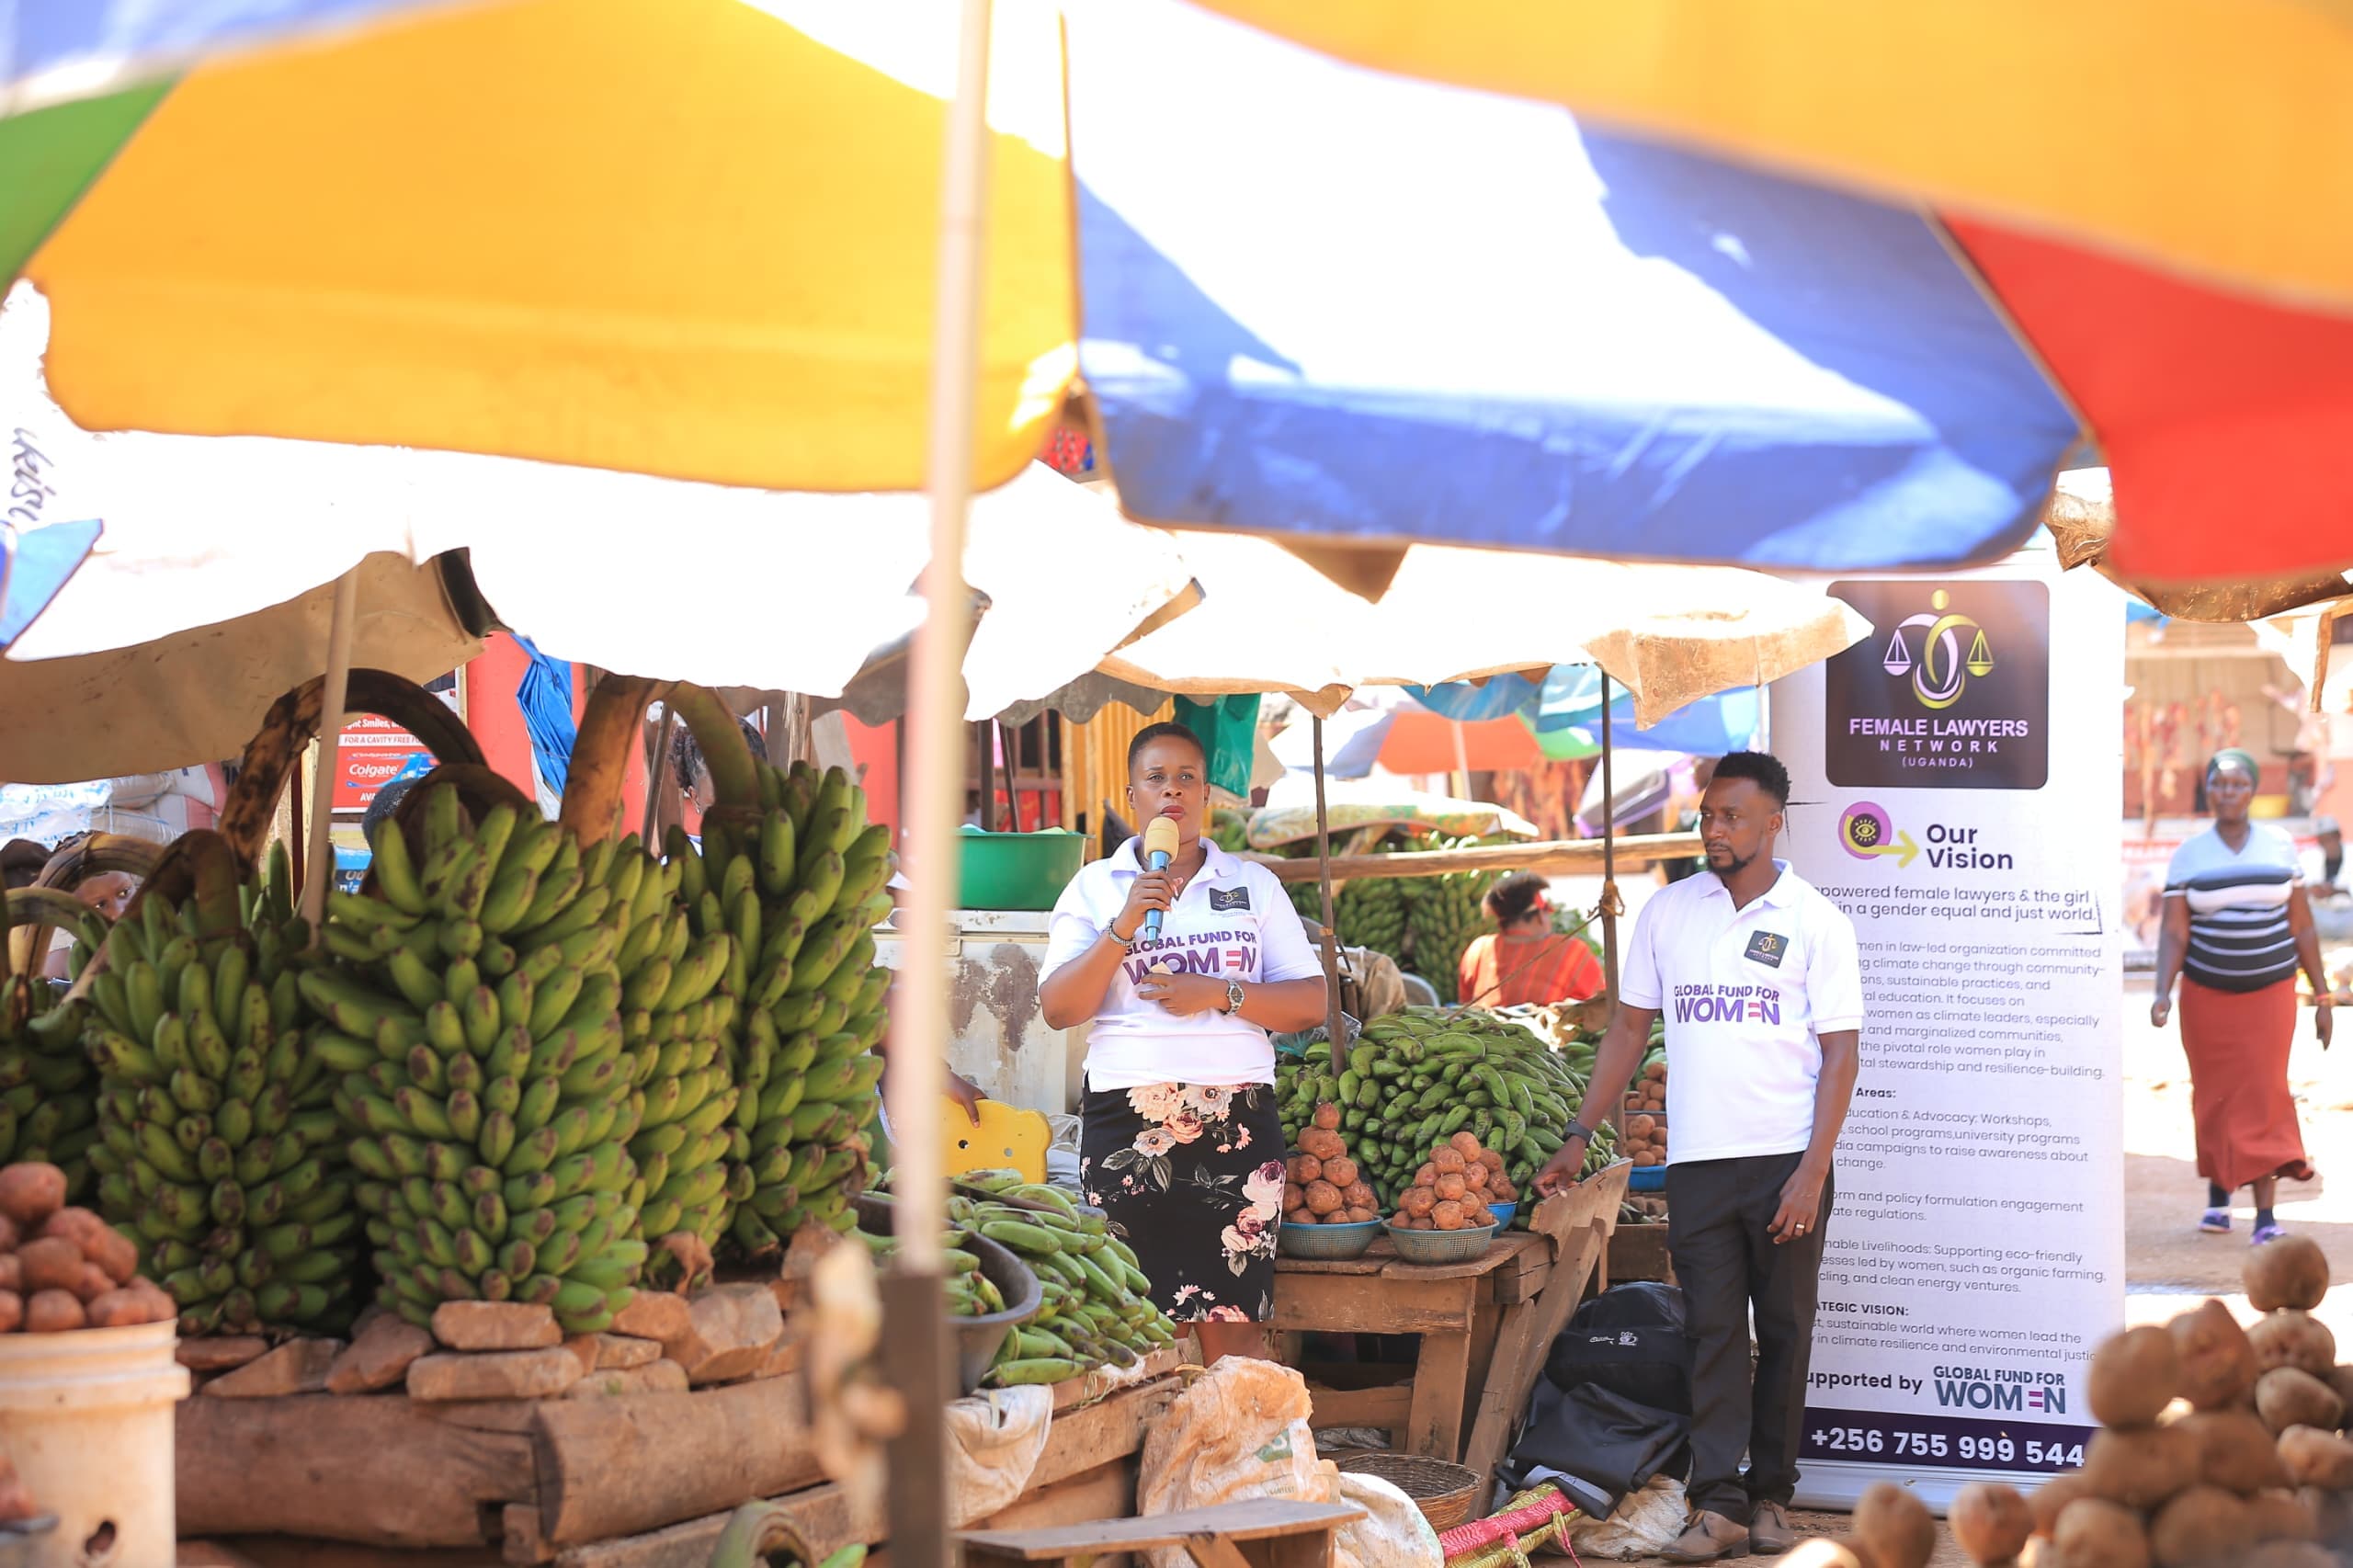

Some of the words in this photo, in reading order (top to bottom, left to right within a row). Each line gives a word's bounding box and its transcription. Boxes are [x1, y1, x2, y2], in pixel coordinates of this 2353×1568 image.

[1849, 718, 1927, 735] FEMALE
[1933, 719, 2029, 736] LAWYERS
[1880, 739, 1998, 753] NETWORK
[349, 763, 398, 778] Colgate
[1902, 756, 1973, 768] (UGANDA)
[1927, 824, 1978, 844] Our
[1927, 846, 2013, 869] Vision
[1814, 886, 1890, 898] powered
[1894, 886, 1949, 899] female
[1954, 887, 2016, 904] lawyers
[2018, 890, 2029, 902] &
[2034, 890, 2060, 903] the
[2064, 890, 2089, 907] girl
[1857, 905, 1867, 915] a
[1870, 903, 1927, 919] gender
[1930, 904, 1976, 921] equal
[1980, 905, 2012, 918] and
[2015, 905, 2044, 923] just
[1188, 931, 1233, 946] FUND
[1234, 931, 1257, 944] FOR
[1886, 941, 1896, 951] in
[1899, 942, 1946, 953] law-led
[1949, 944, 2027, 957] organization
[2030, 947, 2101, 958] committed
[1873, 958, 1919, 970] climate
[1922, 960, 1971, 974] change
[1973, 960, 2023, 975] through
[2026, 963, 2106, 978] community-
[1887, 975, 1959, 987] sustainable
[1961, 978, 2023, 990] practices,
[2025, 980, 2051, 990] and
[1674, 983, 1714, 997] GLOBAL
[1718, 984, 1753, 997] FUND
[1756, 985, 1780, 1002] FOR
[1878, 993, 1943, 1003] education.
[1947, 994, 1954, 1003] It
[1957, 994, 2006, 1006] focuses
[2008, 997, 2025, 1006] on
[1867, 1009, 1913, 1019] women
[1915, 1011, 1931, 1020] as
[1933, 1009, 1981, 1021] climate
[1984, 1012, 2033, 1025] leaders,
[2035, 1015, 2099, 1028] especially
[1868, 1026, 1892, 1035] and
[1895, 1027, 1975, 1040] marginalized
[1978, 1029, 2063, 1043] communities,
[1860, 1041, 1881, 1051] the
[1883, 1041, 1925, 1054] pivotal
[1928, 1044, 1951, 1054] role
[1955, 1046, 2002, 1056] women
[2005, 1047, 2031, 1060] play
[2034, 1047, 2045, 1058] in
[1878, 1058, 1954, 1074] stewardship
[1957, 1062, 1983, 1073] and
[1856, 1087, 1896, 1098] Areas:
[1901, 1110, 1910, 1119] &
[1981, 1113, 2052, 1129] Workshops,
[1847, 1125, 1888, 1135] school
[2018, 1132, 2080, 1146] programs
[1856, 1142, 1927, 1156] campaigns
[1930, 1145, 1942, 1155] to
[1945, 1145, 1976, 1156] raise
[1978, 1148, 2048, 1160] awareness
[2051, 1151, 2088, 1162] about
[1836, 1157, 1887, 1171] change.
[1859, 1192, 1882, 1201] and
[1885, 1192, 1922, 1207] policy
[1925, 1194, 1997, 1208] formulation
[2000, 1199, 2084, 1213] engagement
[1856, 1209, 1927, 1221] regulations.
[1861, 1240, 1931, 1254] Livelihoods:
[1934, 1244, 2002, 1261] Supporting
[2006, 1250, 2083, 1265] eco-friendly
[1858, 1256, 1877, 1267] led
[1880, 1257, 1895, 1271] by
[1897, 1262, 1947, 1273] women,
[1949, 1263, 1980, 1273] such
[1982, 1266, 1997, 1275] as
[2000, 1266, 2050, 1278] organic
[1853, 1274, 1877, 1284] and
[1880, 1275, 1915, 1286] clean
[1917, 1279, 1961, 1292] energy
[1964, 1281, 2021, 1293] ventures.
[1861, 1304, 1909, 1316] VISION:
[1826, 1319, 1897, 1333] sustainable
[1900, 1324, 1935, 1335] world
[1937, 1325, 1976, 1336] where
[1978, 1329, 2027, 1340] women
[2029, 1331, 2057, 1342] lead
[2061, 1333, 2081, 1344] the
[1817, 1334, 1828, 1344] in
[1831, 1335, 1877, 1347] climate
[1880, 1338, 1938, 1351] resilience
[1941, 1343, 1967, 1353] and
[1969, 1345, 2061, 1358] environmental
[1898, 1375, 1923, 1395] by
[1933, 1365, 1991, 1381] GLOBAL
[1995, 1369, 2033, 1384] FUND
[2036, 1372, 2065, 1386] FOR
[1812, 1427, 1883, 1453] +256
[1892, 1431, 1949, 1457] 755
[1958, 1436, 2015, 1461] 999
[2025, 1440, 2085, 1467] 544
